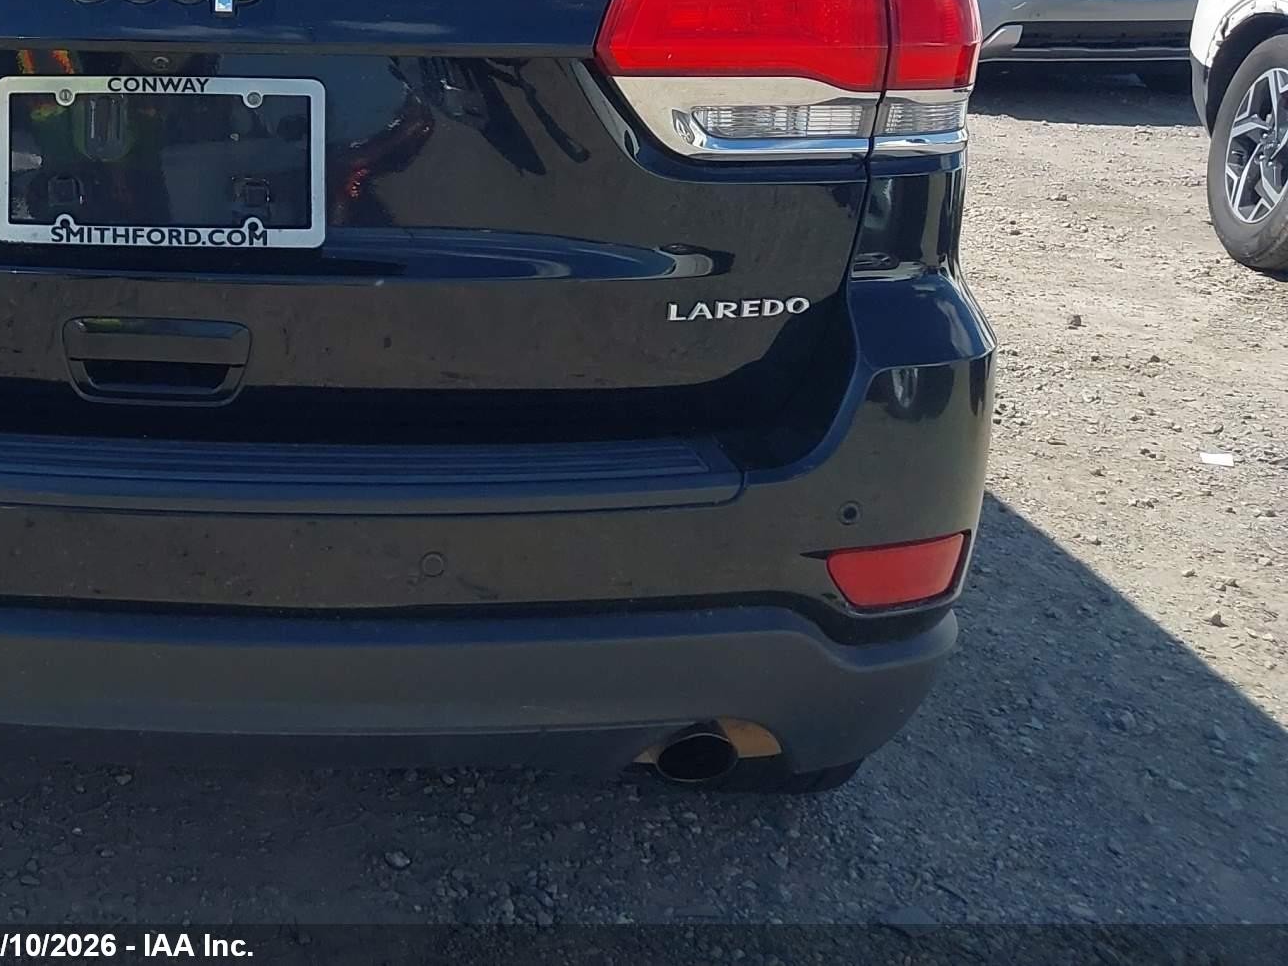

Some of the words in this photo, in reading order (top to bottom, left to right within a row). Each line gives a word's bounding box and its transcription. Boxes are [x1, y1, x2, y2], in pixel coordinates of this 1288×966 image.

[107, 77, 210, 93] CONWAY
[50, 225, 268, 246] SMITHFORD.COM
[666, 296, 811, 321] LAREDO
